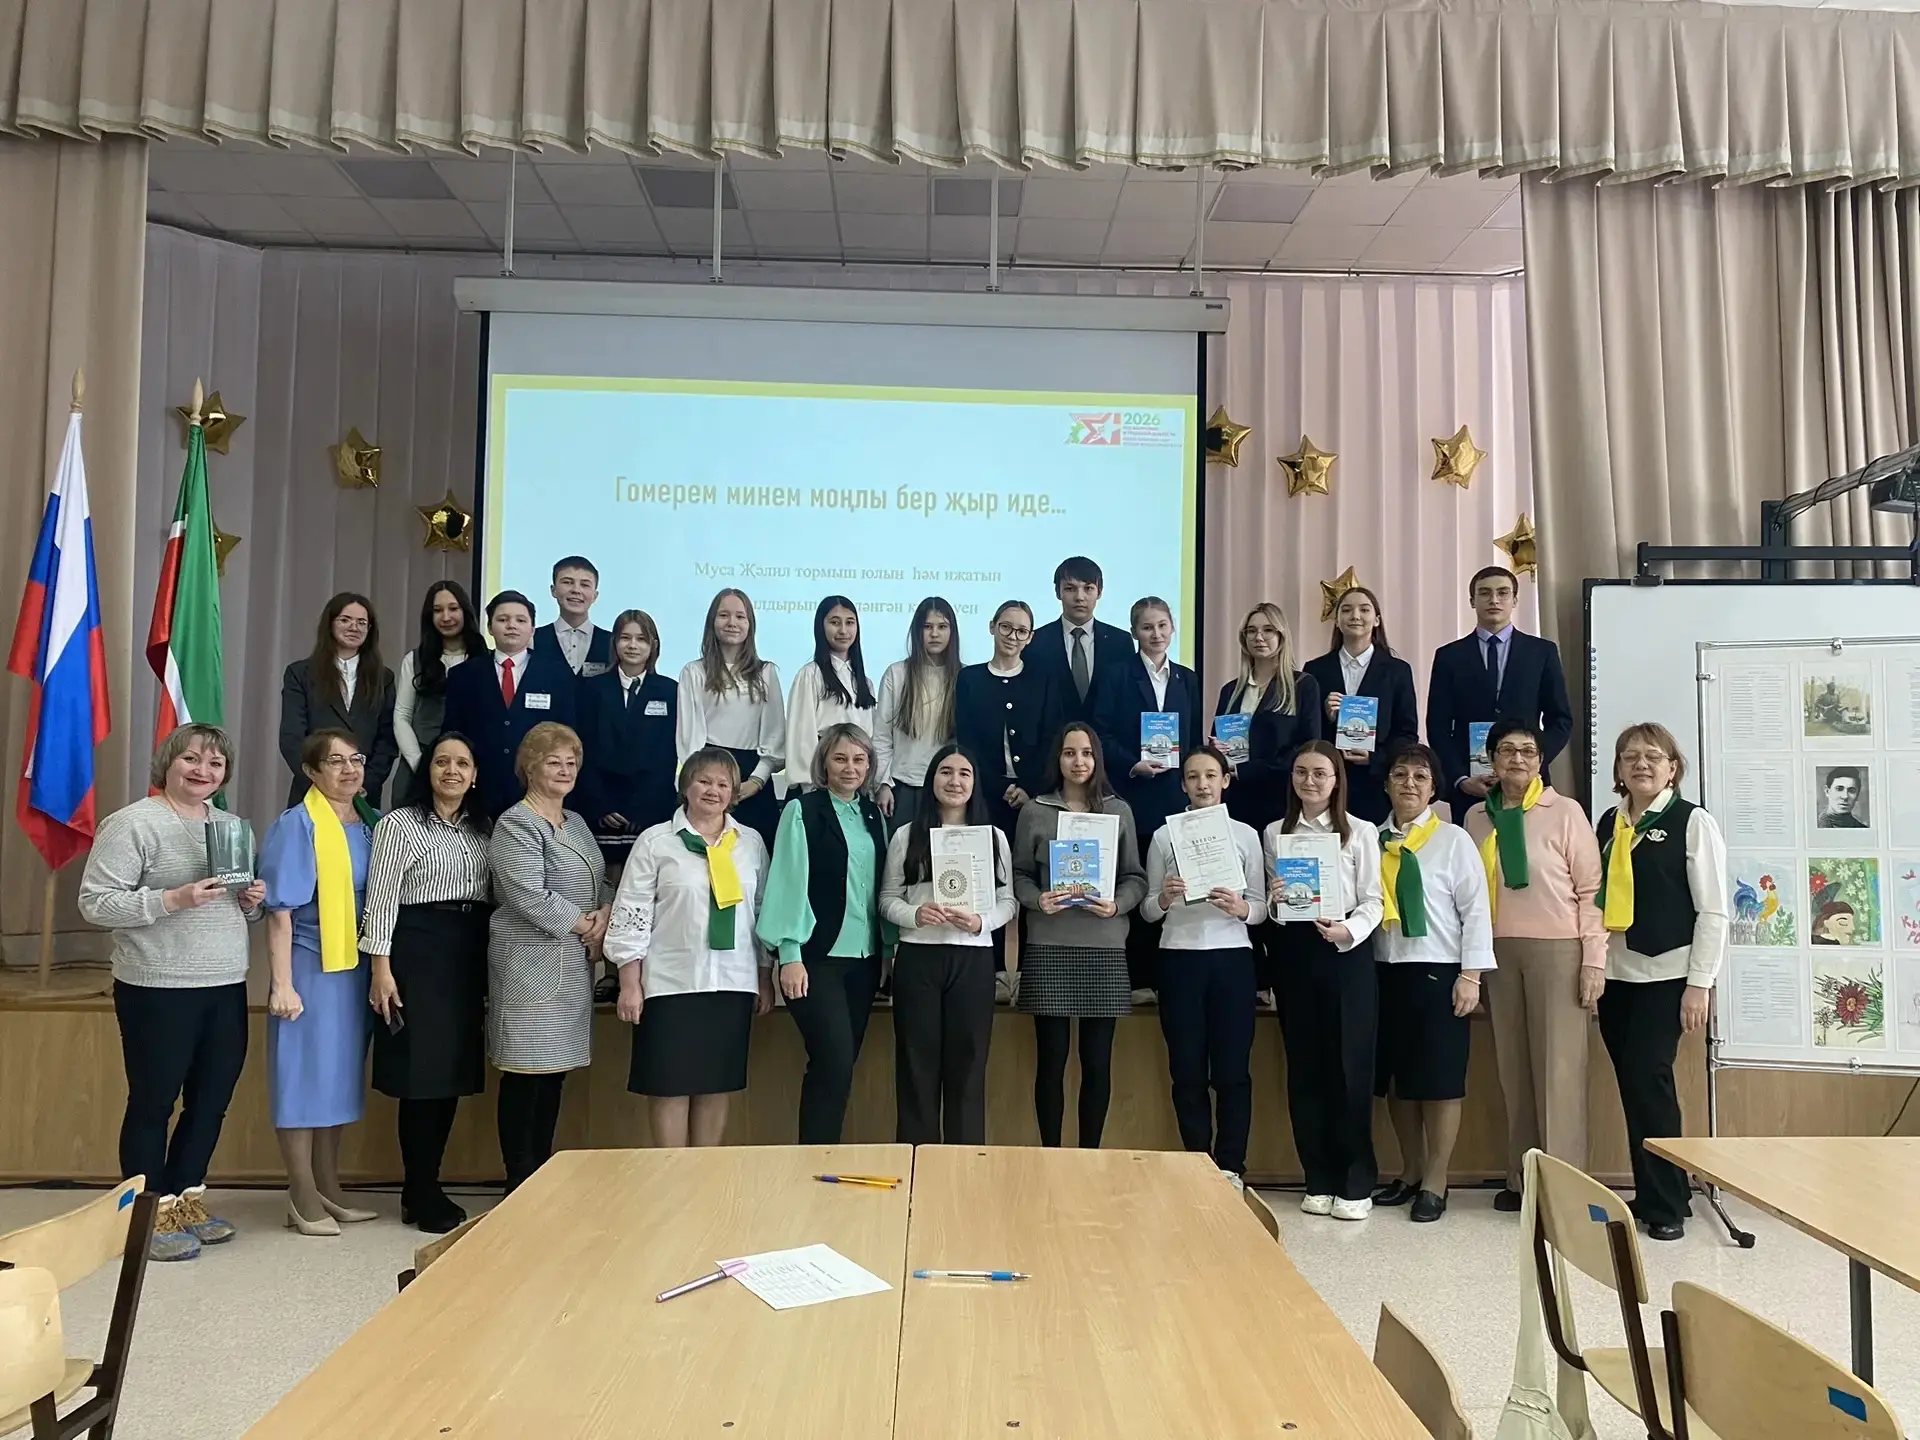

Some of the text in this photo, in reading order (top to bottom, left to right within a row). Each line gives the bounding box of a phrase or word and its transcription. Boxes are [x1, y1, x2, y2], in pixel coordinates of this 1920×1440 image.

[1124, 413, 1160, 425] 2026
[615, 476, 717, 510] Гомерем
[726, 486, 801, 506] минем
[810, 488, 887, 513] моңлы
[896, 484, 937, 518] бер
[945, 492, 999, 519] җыр
[694, 563, 1002, 582] Муса Җәлил тормыш юлын һәм иҗатын
